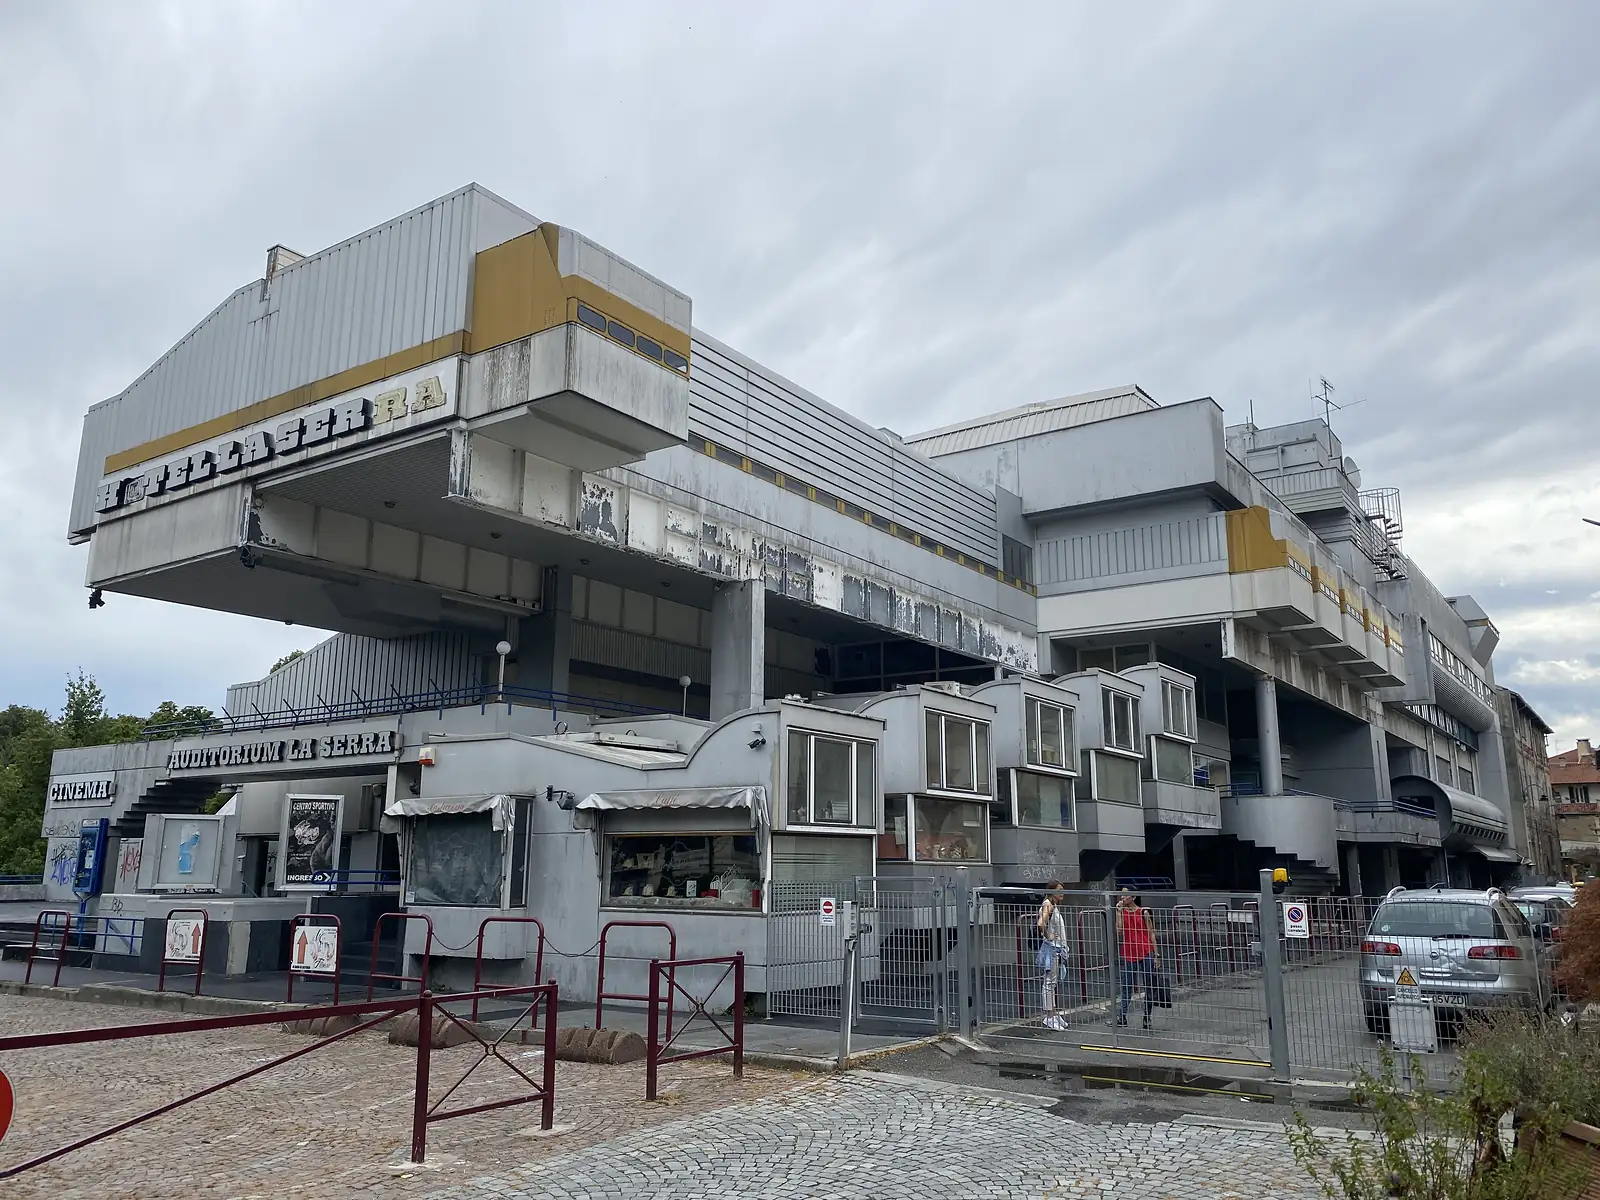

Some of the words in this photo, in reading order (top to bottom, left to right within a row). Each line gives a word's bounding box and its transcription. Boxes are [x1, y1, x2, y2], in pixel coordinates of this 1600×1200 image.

[168, 740, 283, 770] AUDITORIUM
[286, 738, 314, 761] LA
[319, 730, 393, 758] SERRA
[49, 780, 109, 801] CINEMA
[293, 802, 311, 811] CENTRO
[312, 802, 335, 811] SPORTIVO
